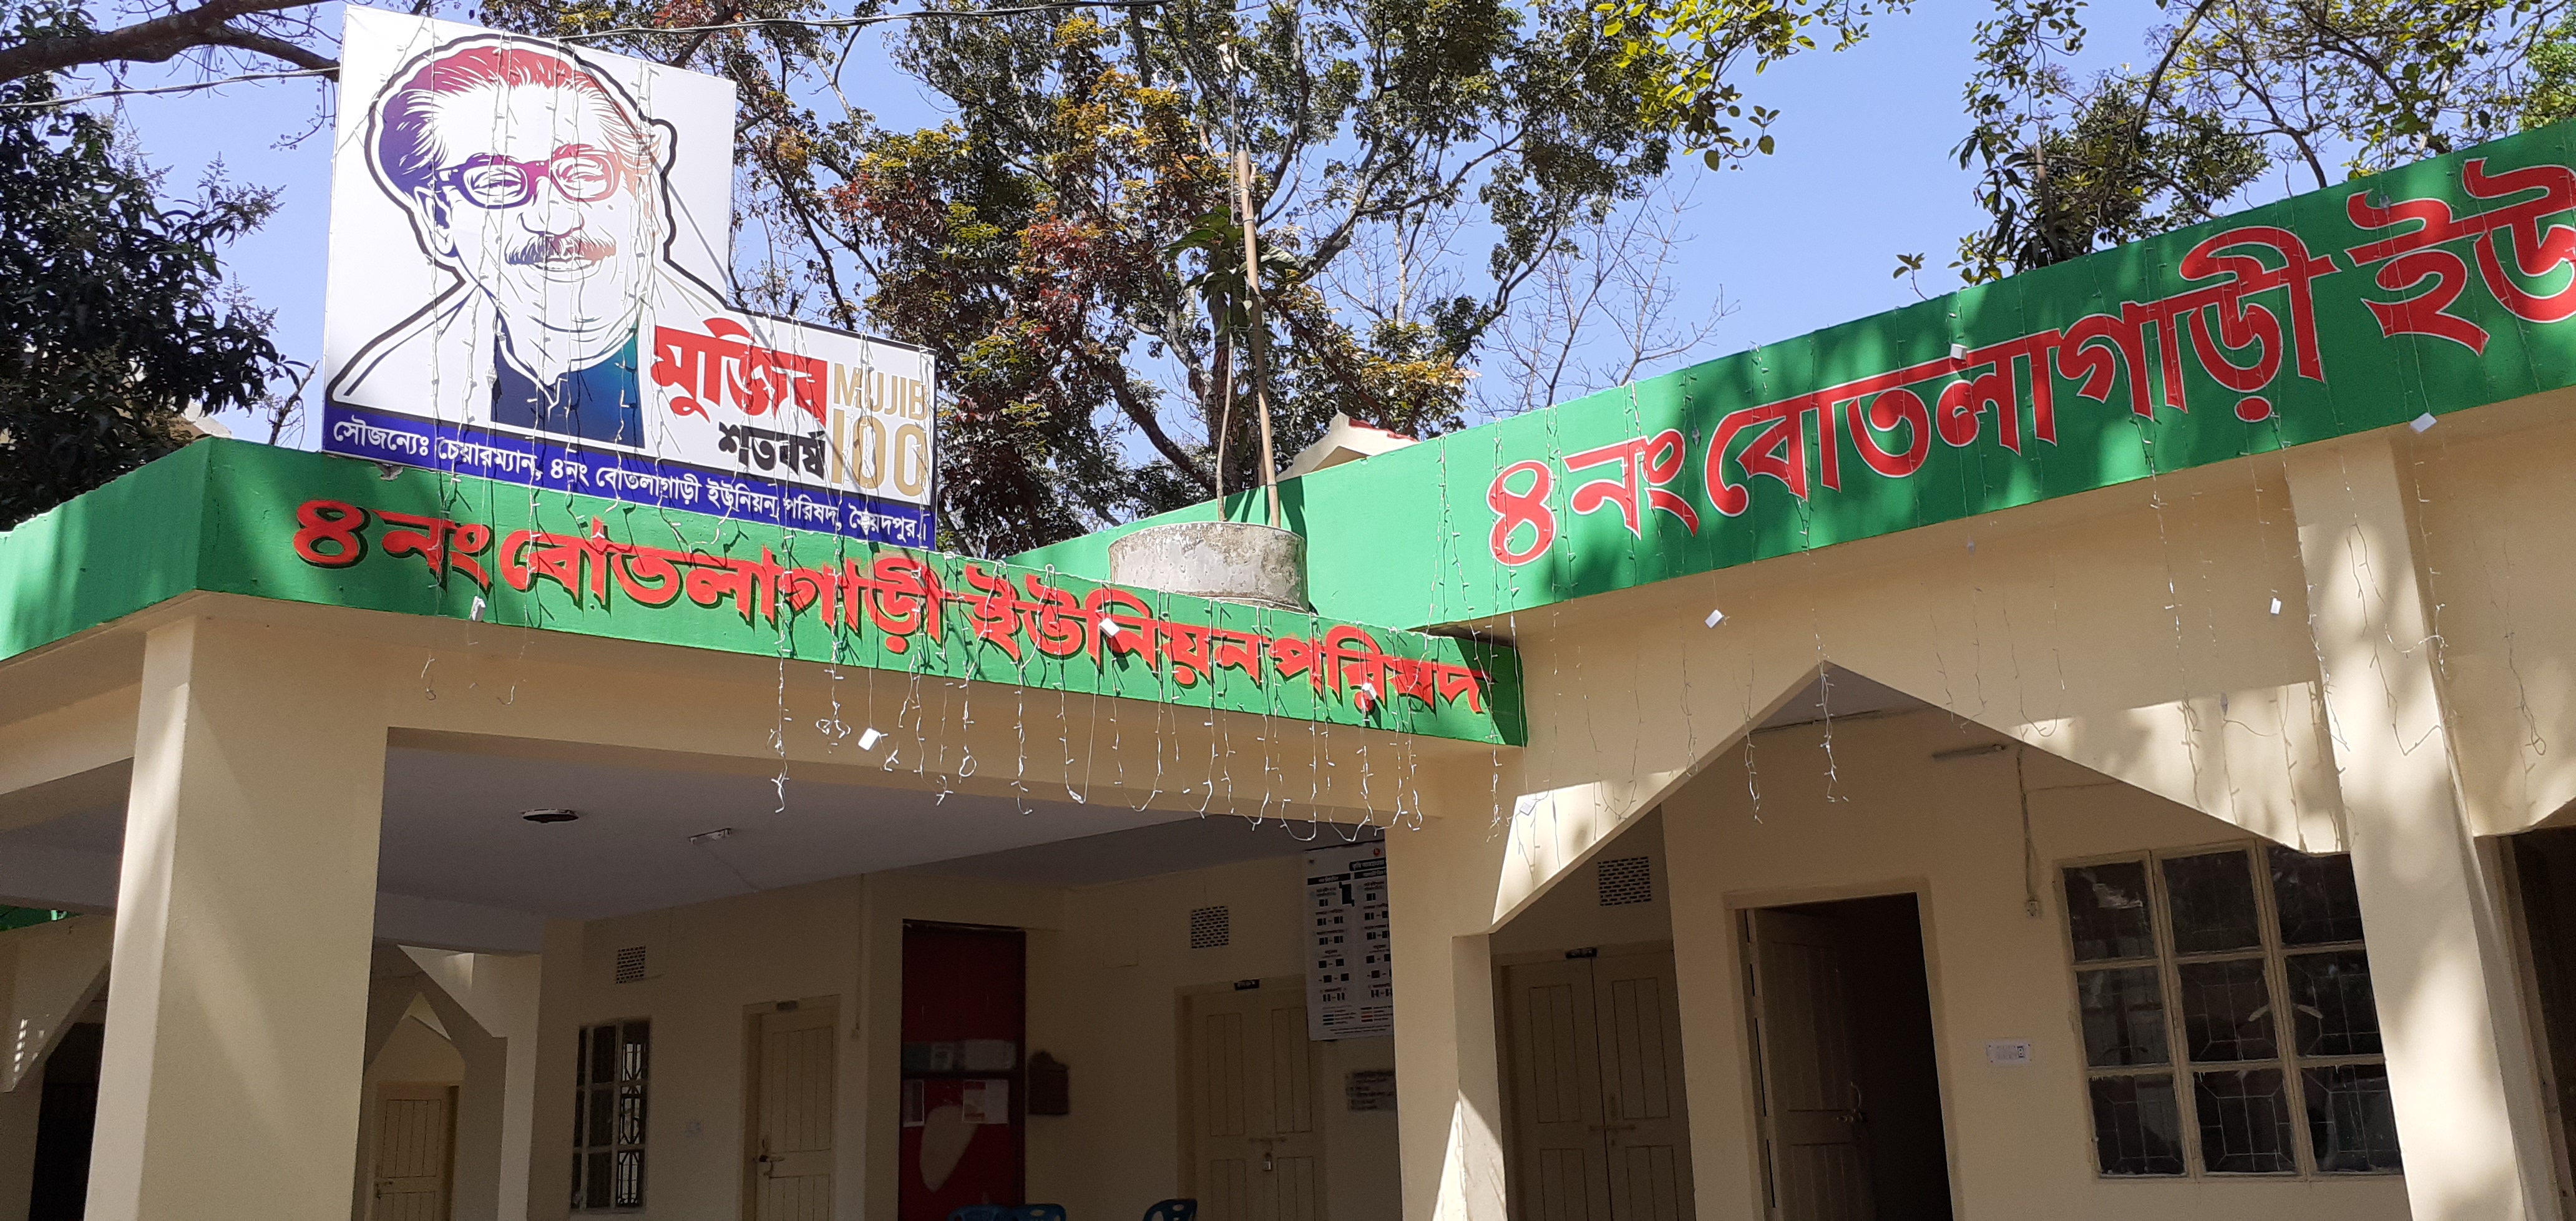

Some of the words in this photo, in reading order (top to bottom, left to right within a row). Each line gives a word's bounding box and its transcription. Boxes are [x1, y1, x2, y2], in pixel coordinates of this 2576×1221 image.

[651, 317, 827, 428] মুজিব
[834, 363, 929, 421] MUJIB
[1486, 460, 1556, 566] ৪
[1561, 429, 1699, 541] নং
[1705, 225, 2341, 517] বোতলাগাড়ী
[596, 467, 703, 506] বোতলাগাড়ী
[706, 478, 779, 516] ইউনিয়ন
[718, 421, 826, 480] শতবর্ষ
[831, 409, 927, 497] 100
[293, 499, 368, 567] ৪
[370, 509, 492, 593] নং
[499, 516, 951, 654] বোতলাগাড়ী
